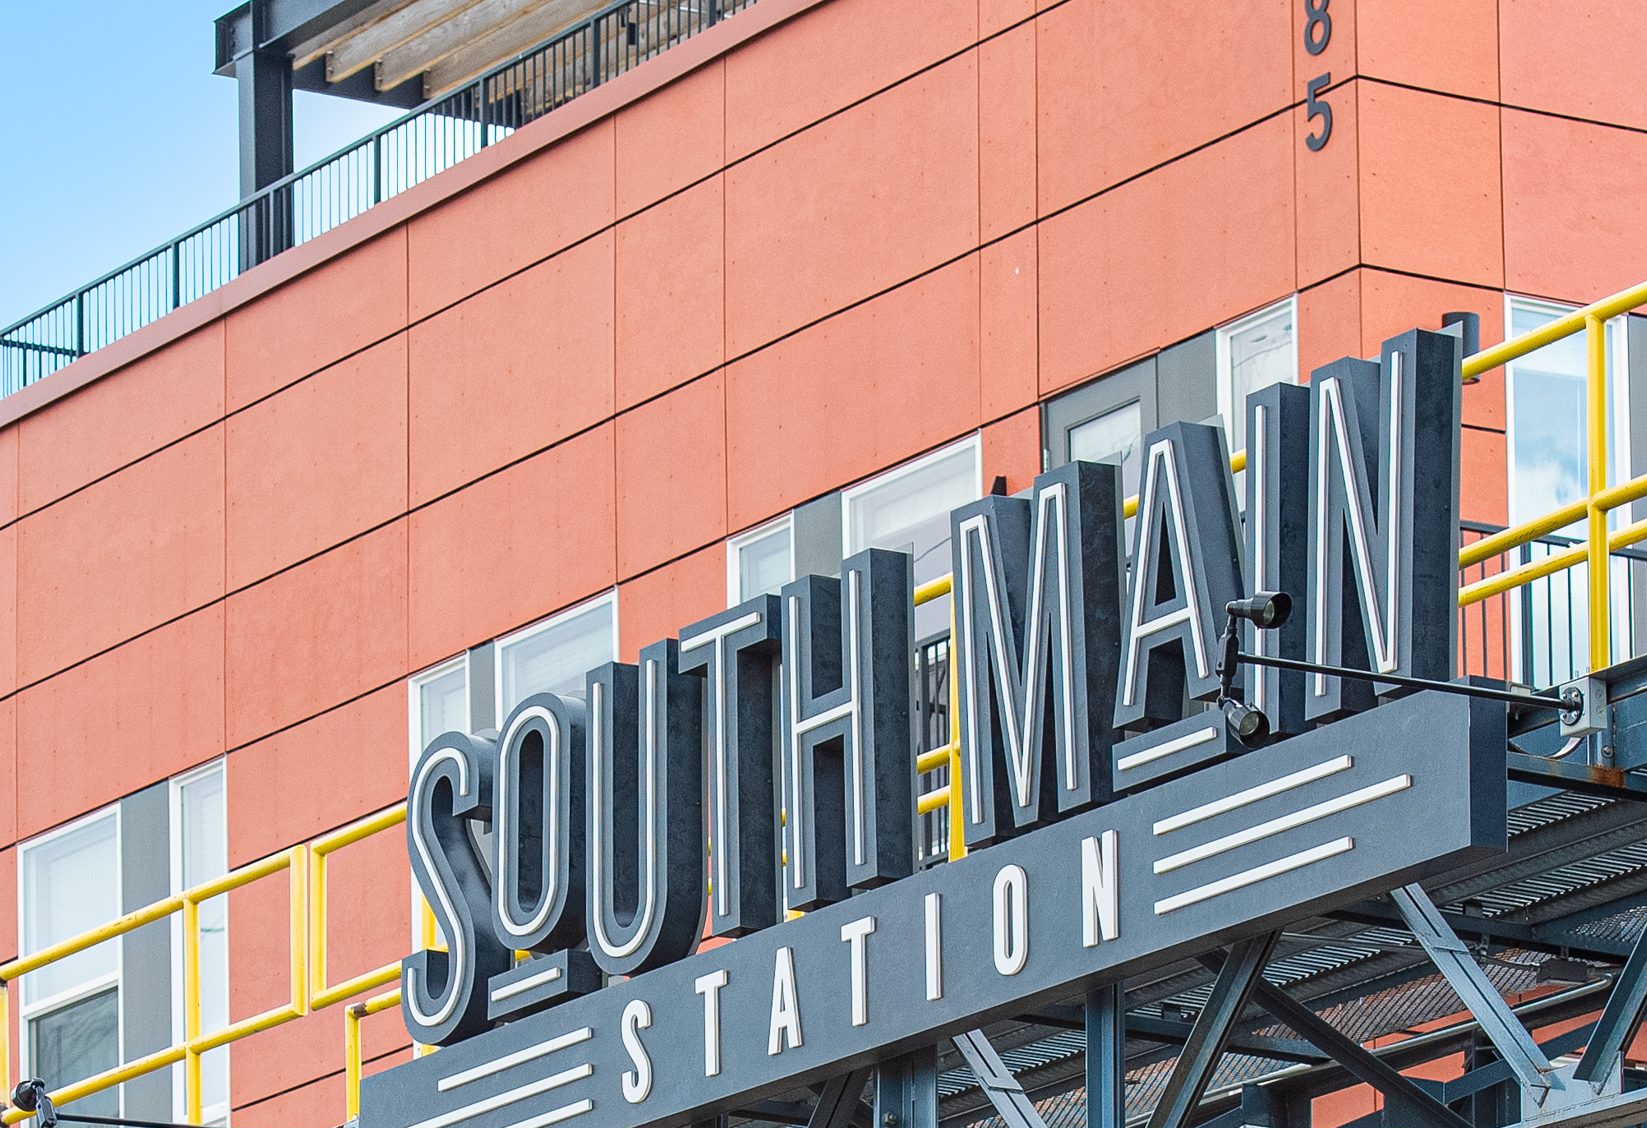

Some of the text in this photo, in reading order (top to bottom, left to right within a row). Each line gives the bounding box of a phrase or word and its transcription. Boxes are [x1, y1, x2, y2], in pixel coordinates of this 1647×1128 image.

[401, 328, 1463, 1046] SOUTH MAIN
[620, 828, 1120, 1106] STATION
